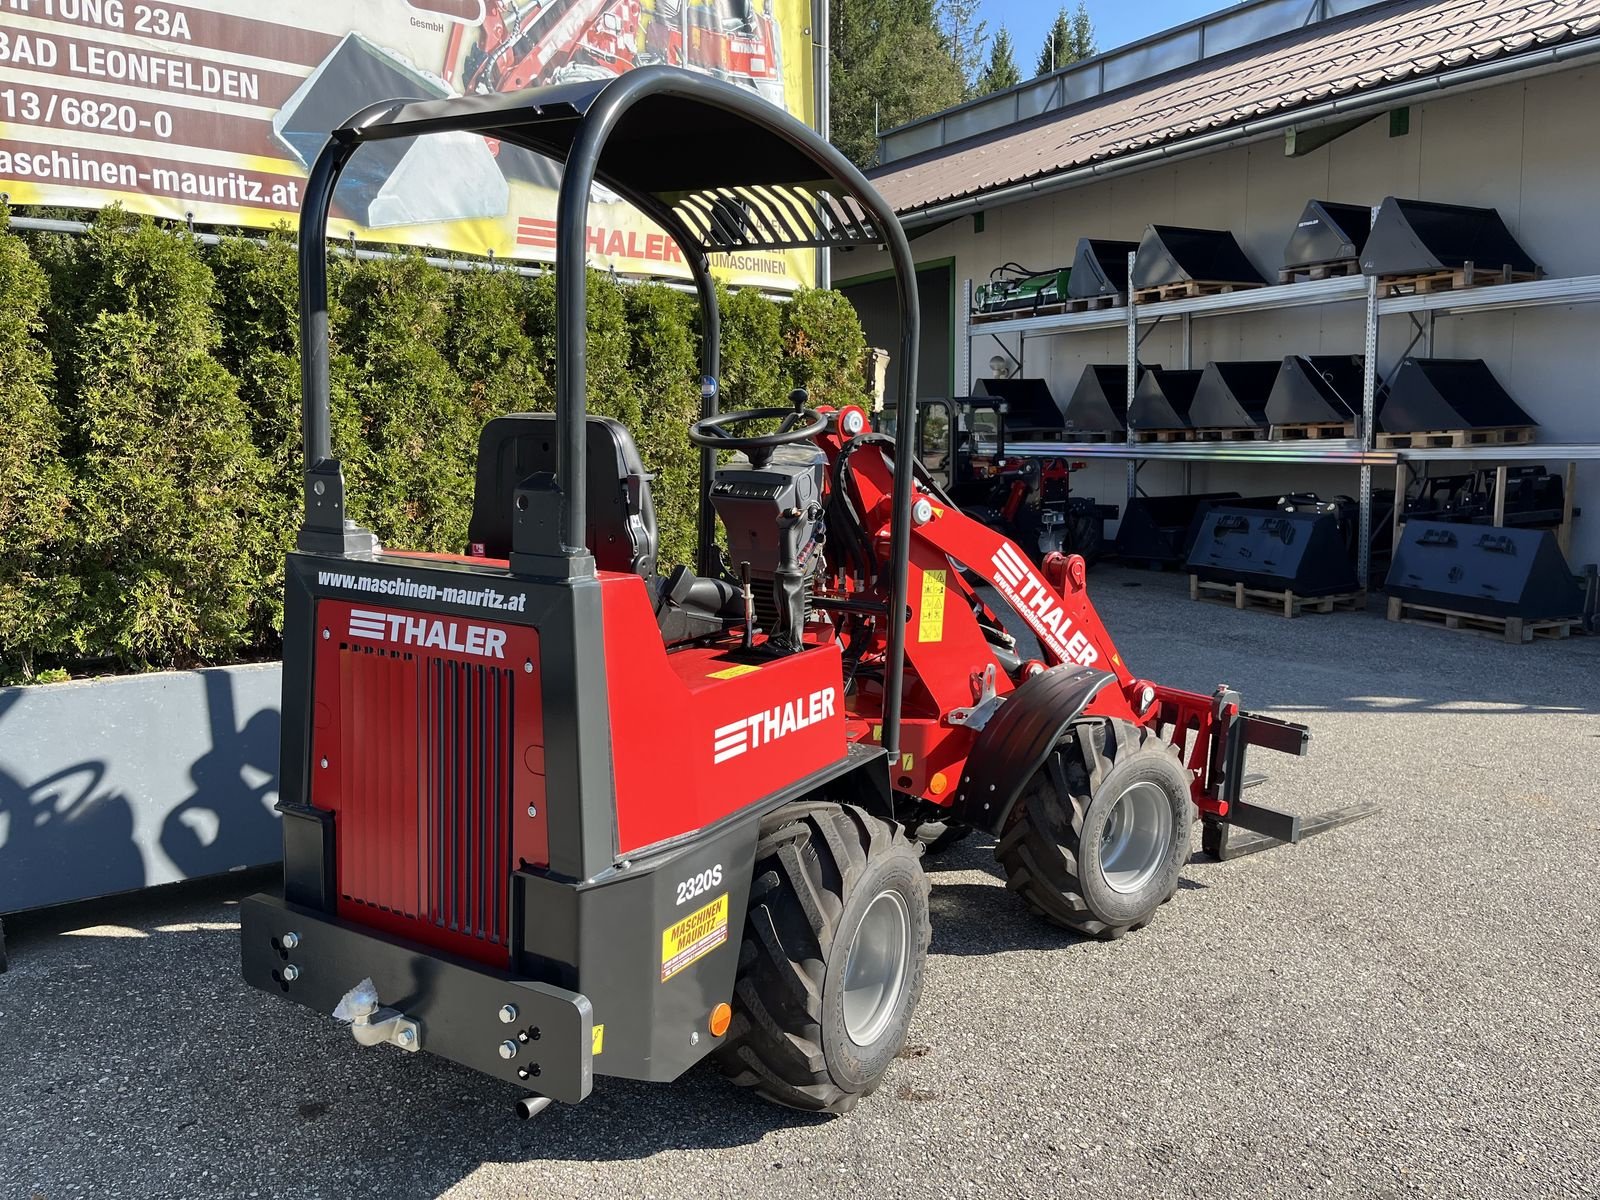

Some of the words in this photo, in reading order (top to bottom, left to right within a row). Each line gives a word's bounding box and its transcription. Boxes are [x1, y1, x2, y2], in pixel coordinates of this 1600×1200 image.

[134, 5, 192, 40] 23A
[410, 16, 444, 33] GesmbH
[69, 43, 259, 99] LEONFELDEN
[585, 226, 682, 263] HALER
[706, 252, 786, 275] UMASCHINEN
[318, 571, 527, 612] www.maschinen-mauritz.at
[676, 863, 723, 906] 2320S
[671, 899, 723, 942] MASCHINEN
[677, 917, 717, 952] MAURITZ
